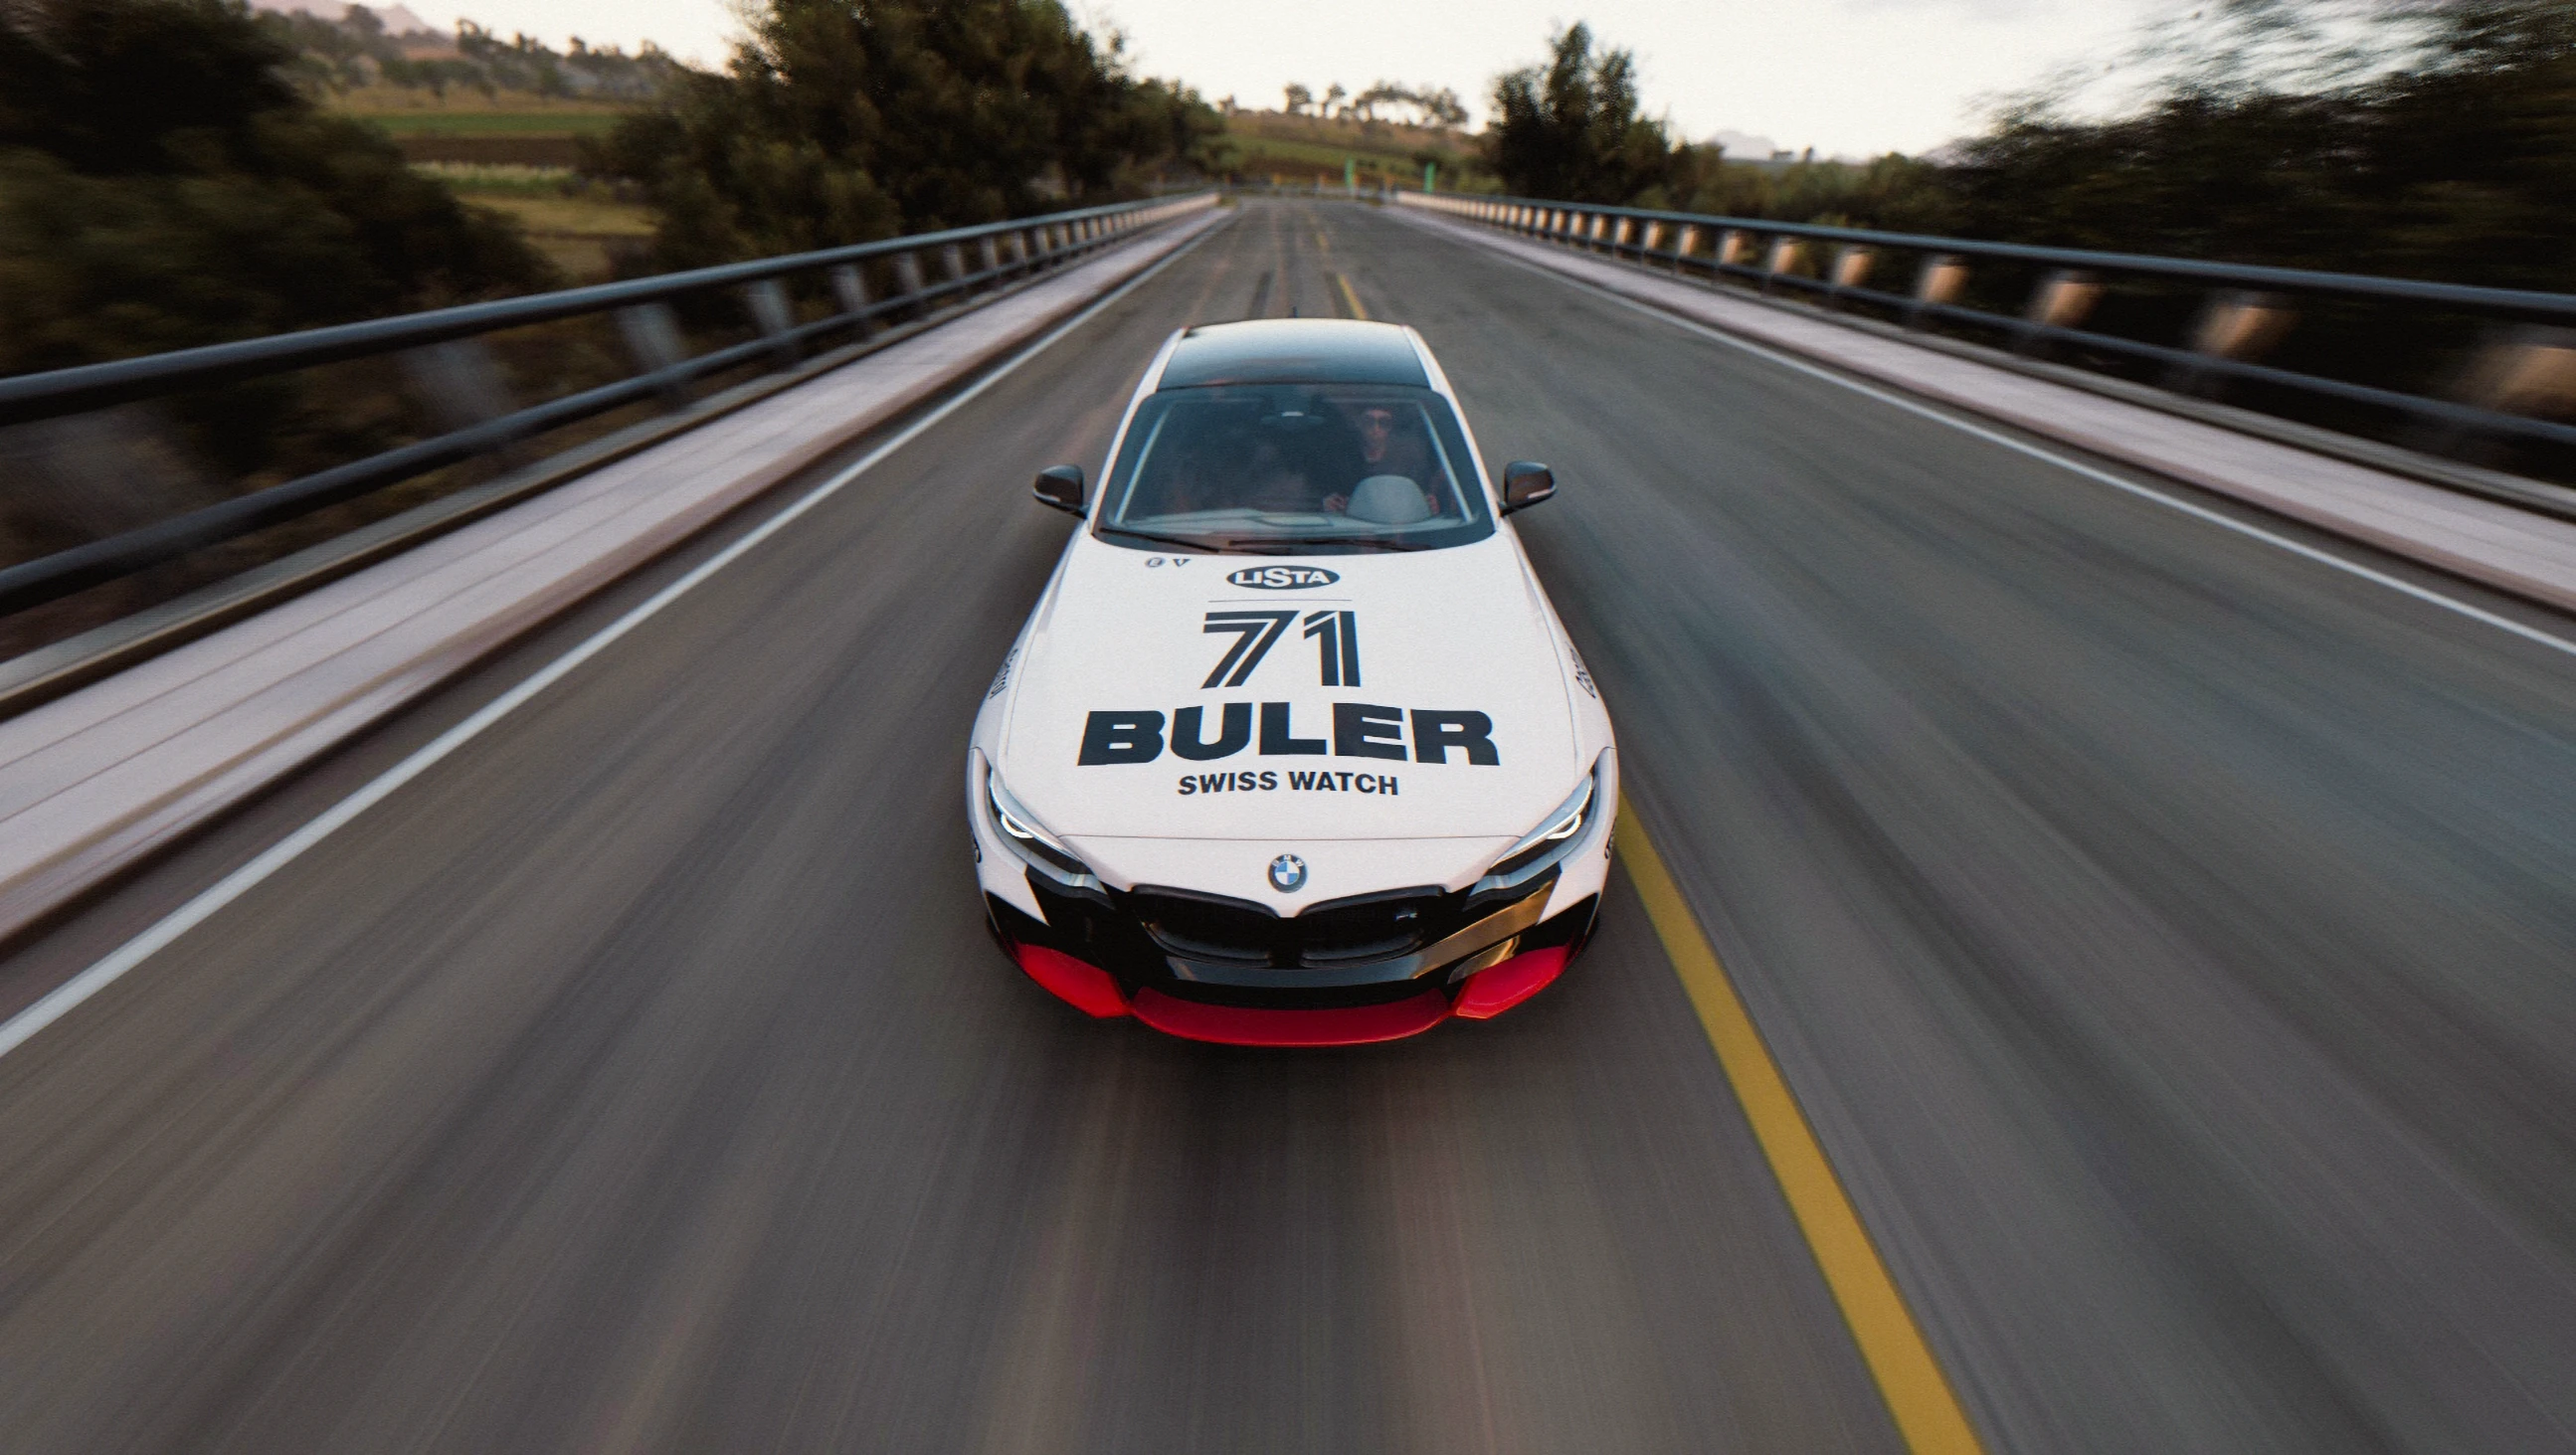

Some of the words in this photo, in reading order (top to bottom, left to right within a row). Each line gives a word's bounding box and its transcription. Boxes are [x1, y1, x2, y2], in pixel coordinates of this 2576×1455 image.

[1234, 567, 1331, 588] LISTA
[1200, 610, 1361, 689] 71
[1077, 701, 1501, 767] BULER
[1178, 771, 1278, 796] SWISS
[1288, 771, 1398, 796] WATCH
